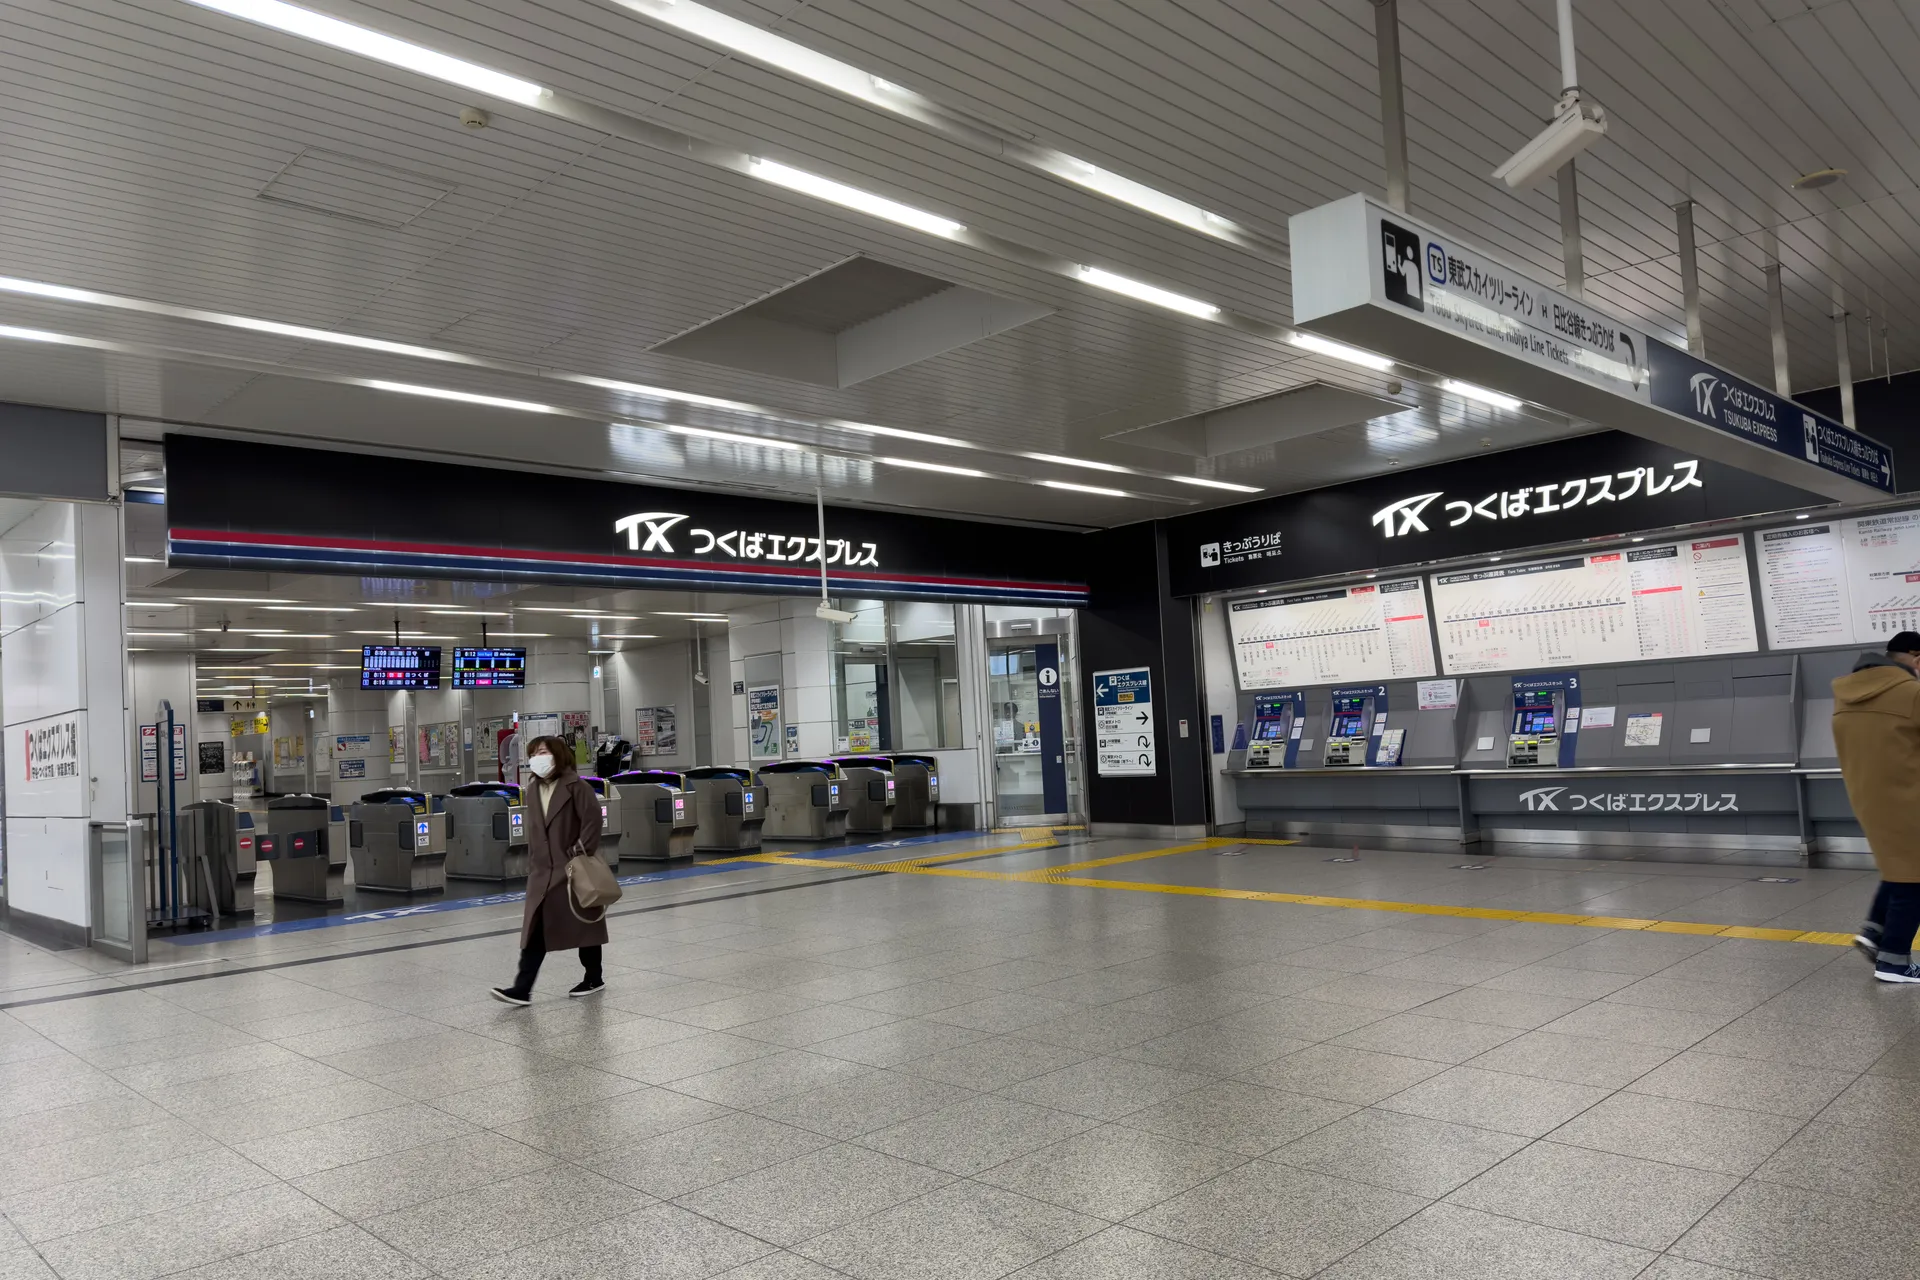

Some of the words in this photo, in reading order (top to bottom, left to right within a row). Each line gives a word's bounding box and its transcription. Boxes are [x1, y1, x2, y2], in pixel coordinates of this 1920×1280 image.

[1431, 253, 1443, 273] TS
[1447, 255, 1534, 317] 東武スカイツリーライン
[1552, 303, 1615, 352] 日比谷線きっぷうりば
[1530, 333, 1546, 357] Line
[1545, 338, 1569, 366] Tickets
[1690, 372, 1719, 419] TX
[1721, 383, 1776, 423] つくばエクスプレス
[1723, 408, 1751, 433] TSUKUBA
[1752, 419, 1778, 443] EXPRESS
[1445, 460, 1703, 527] つくばエクスプレス
[1372, 491, 1444, 538] TX
[1857, 515, 1909, 528] 関東鉄道常総線
[615, 512, 690, 553] TX
[690, 528, 879, 567] つくばエクスプレス
[1223, 531, 1281, 553] きっぷうりば
[1224, 556, 1244, 564] Tickets
[1297, 692, 1302, 702] 1
[1379, 686, 1386, 696] 2
[1569, 678, 1577, 689] 3
[29, 720, 76, 763] つくばエクスプレス線
[1519, 787, 1568, 811] TX
[1569, 793, 1739, 811] つくばエクスプレス
